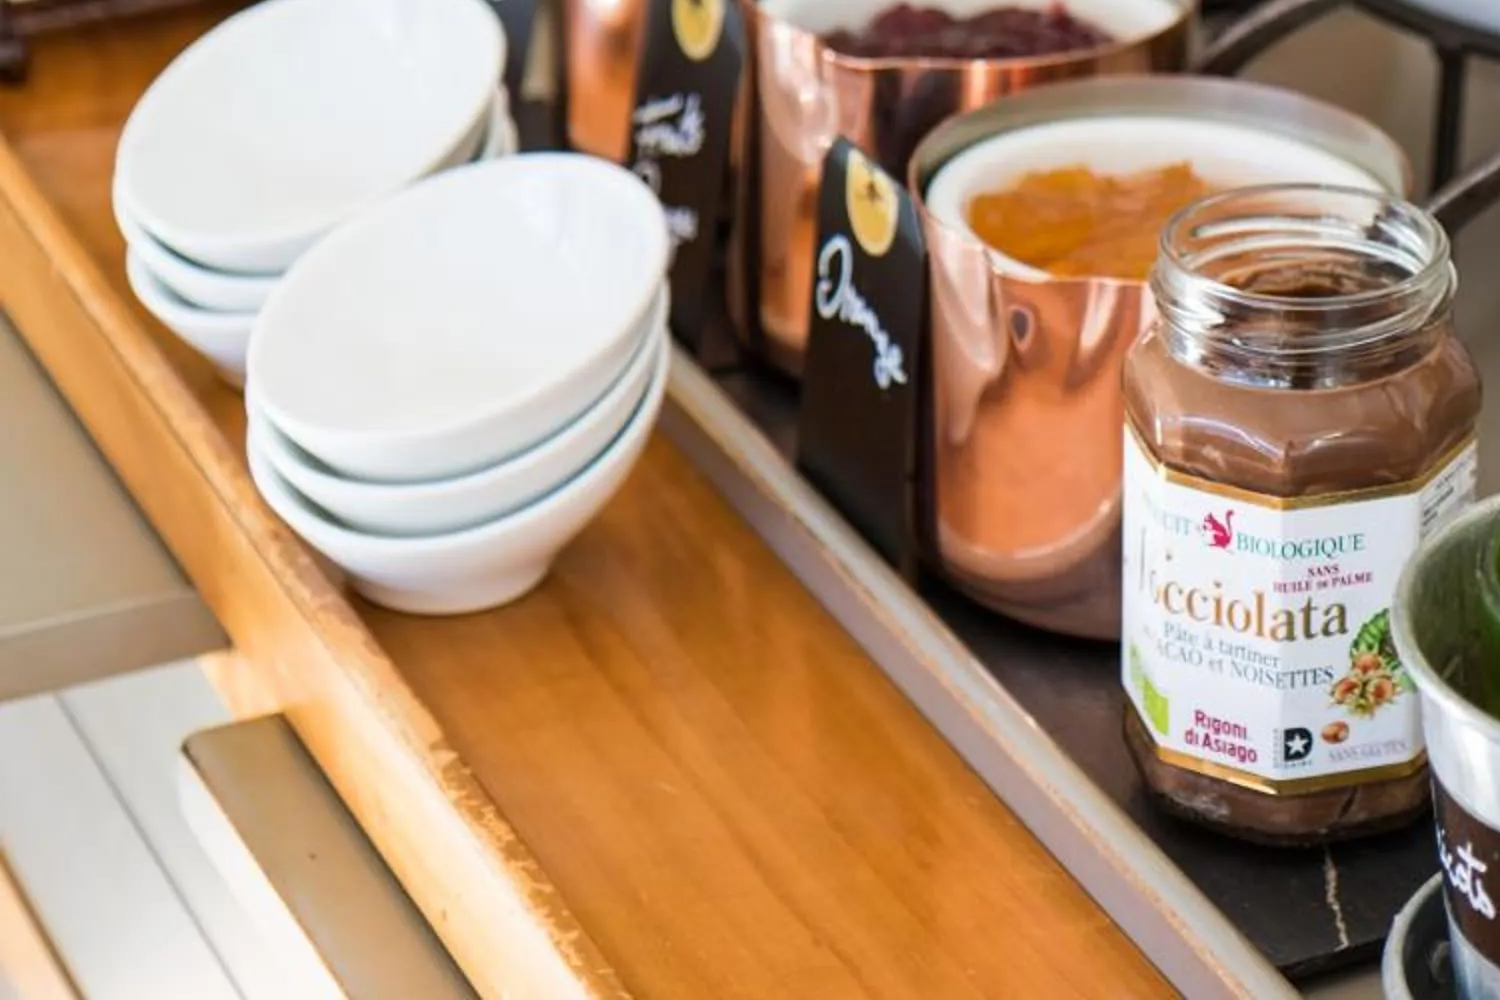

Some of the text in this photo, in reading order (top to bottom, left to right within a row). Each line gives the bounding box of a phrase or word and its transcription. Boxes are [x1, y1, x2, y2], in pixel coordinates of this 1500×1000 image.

[1236, 532, 1366, 559] BIOLOGIQUE
[1307, 564, 1340, 577] SANS
[1331, 571, 1373, 587] PALME
[1156, 639, 1203, 666] ACAO
[1231, 665, 1335, 690] NOISETTES
[1194, 710, 1247, 740] Rigoni
[1184, 729, 1199, 746] di
[1203, 734, 1258, 764] Asiago
